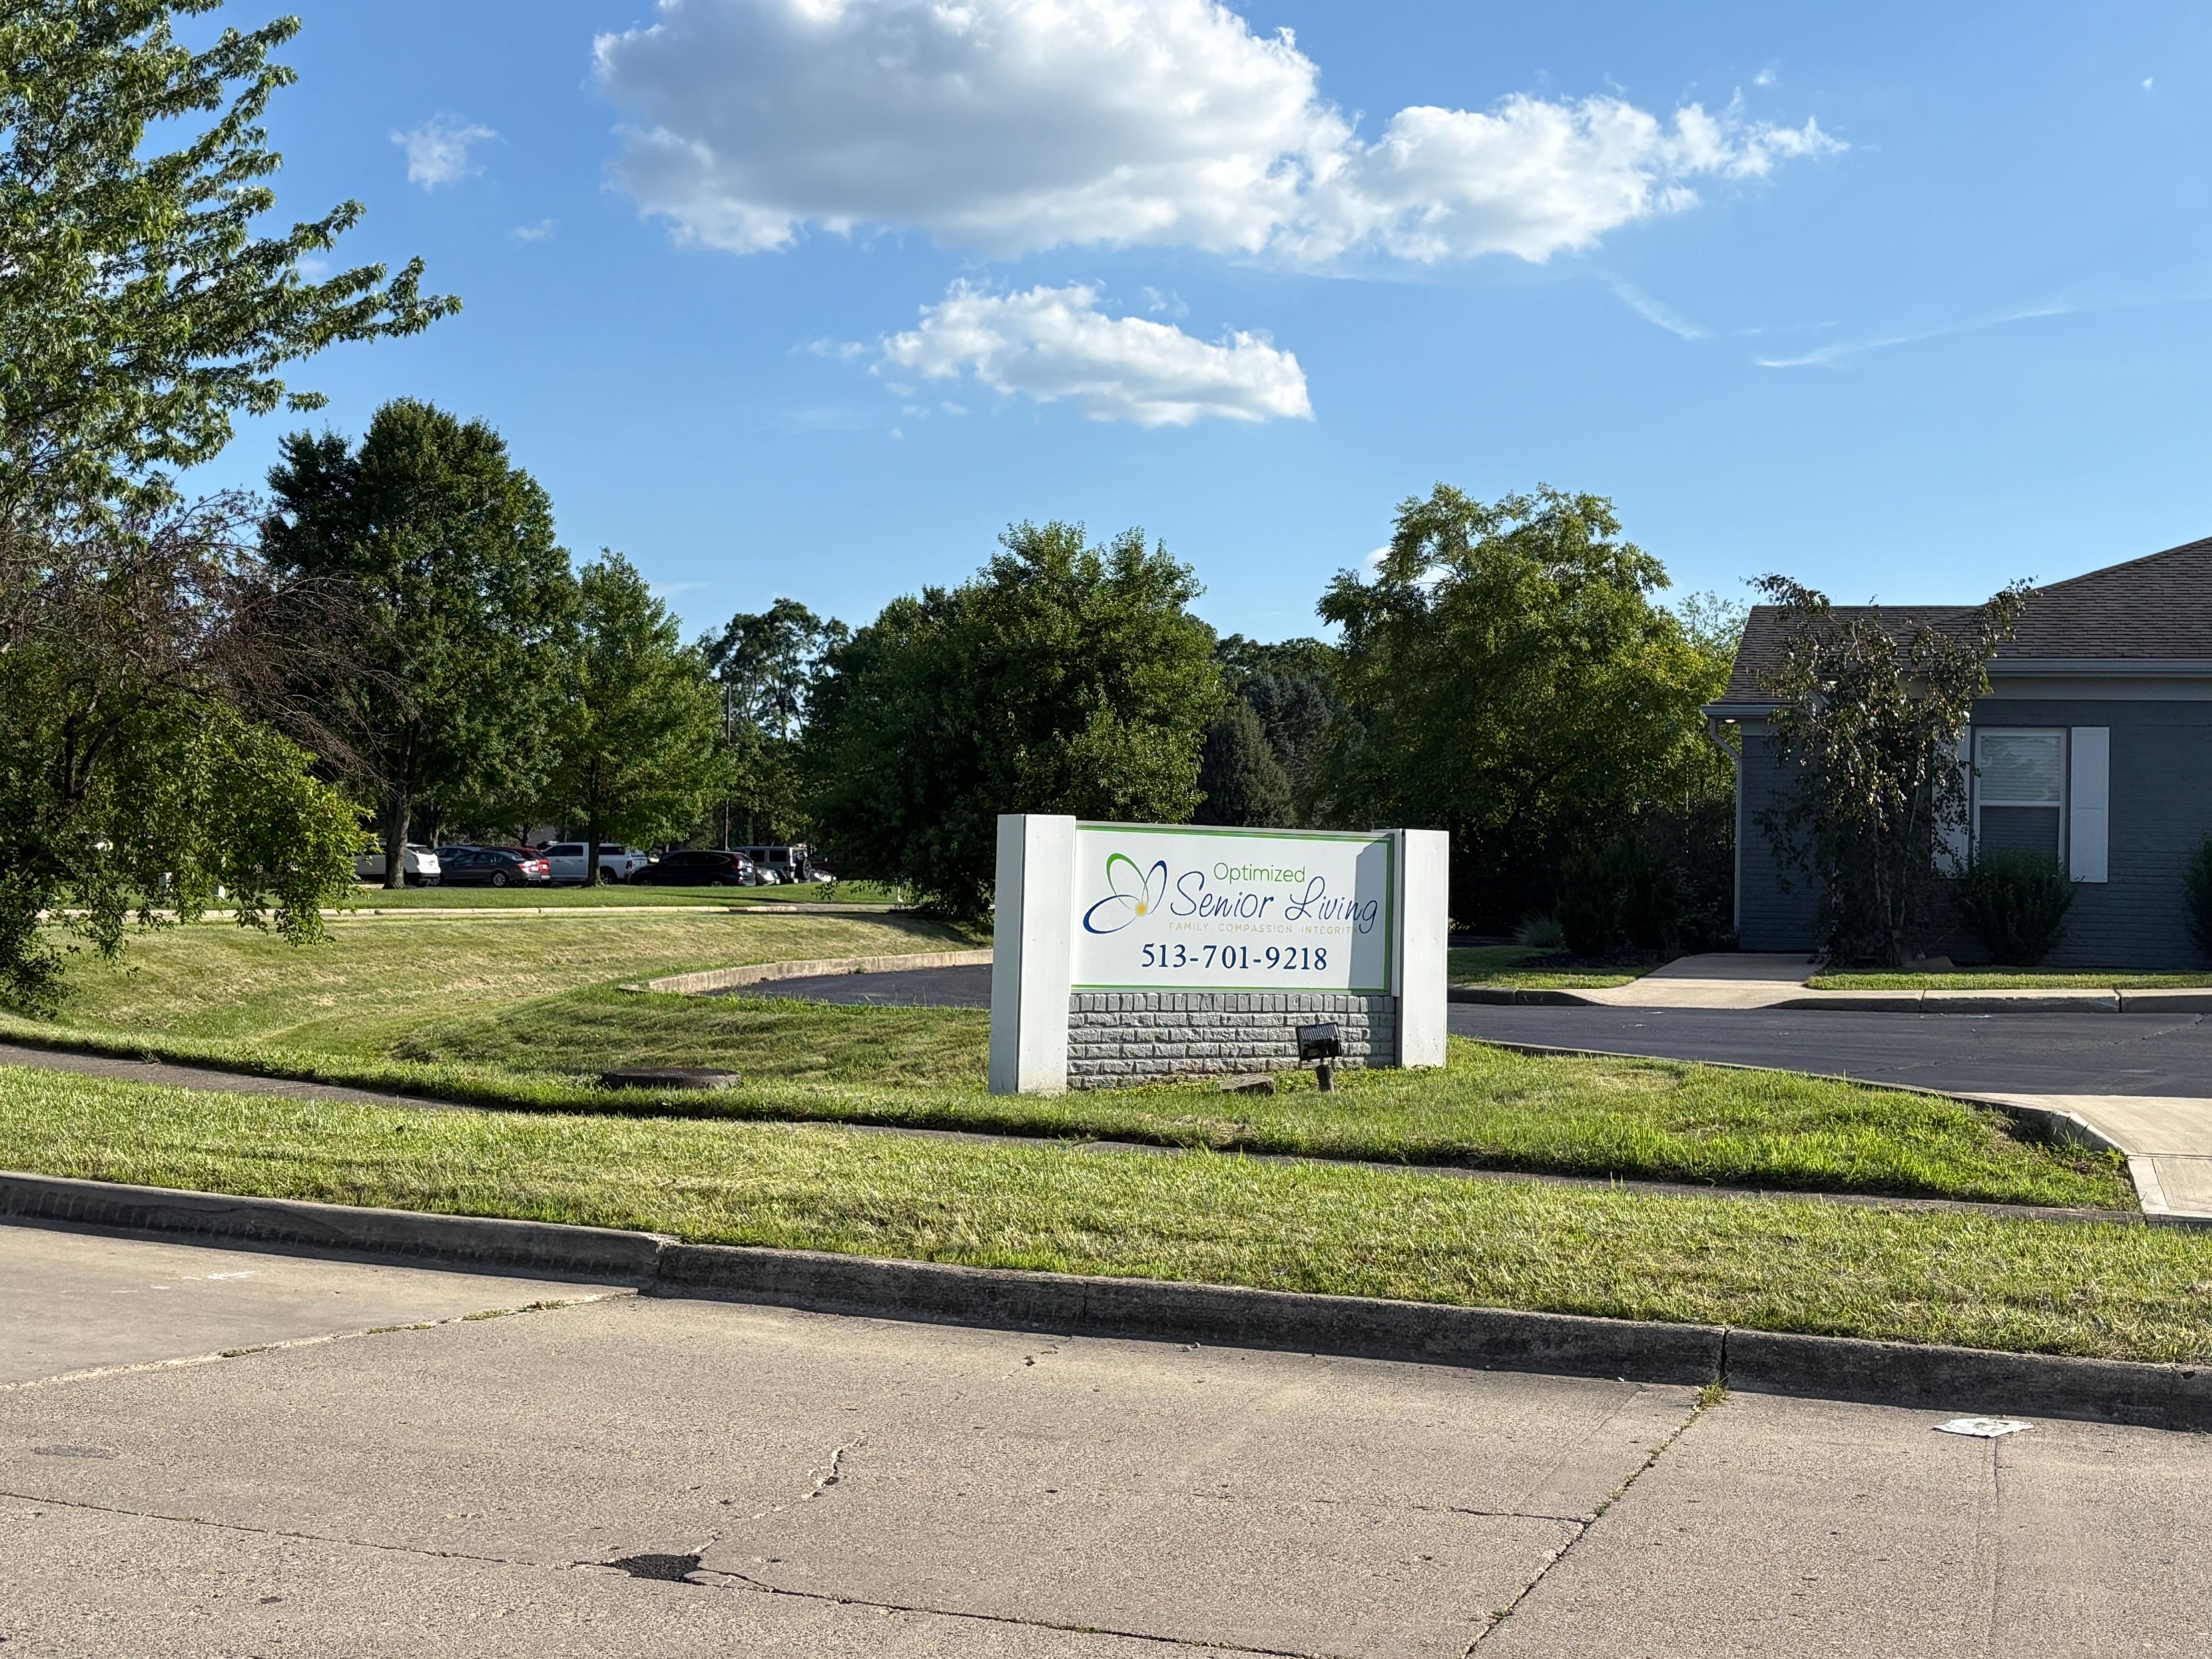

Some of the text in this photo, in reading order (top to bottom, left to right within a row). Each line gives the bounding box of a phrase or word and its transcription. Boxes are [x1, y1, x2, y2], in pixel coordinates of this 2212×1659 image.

[1214, 862, 1305, 884] Optimized
[1170, 870, 1378, 934] Senior Living
[1218, 924, 1293, 933] COMPASSION
[1141, 942, 1328, 971] 513-701-9218
